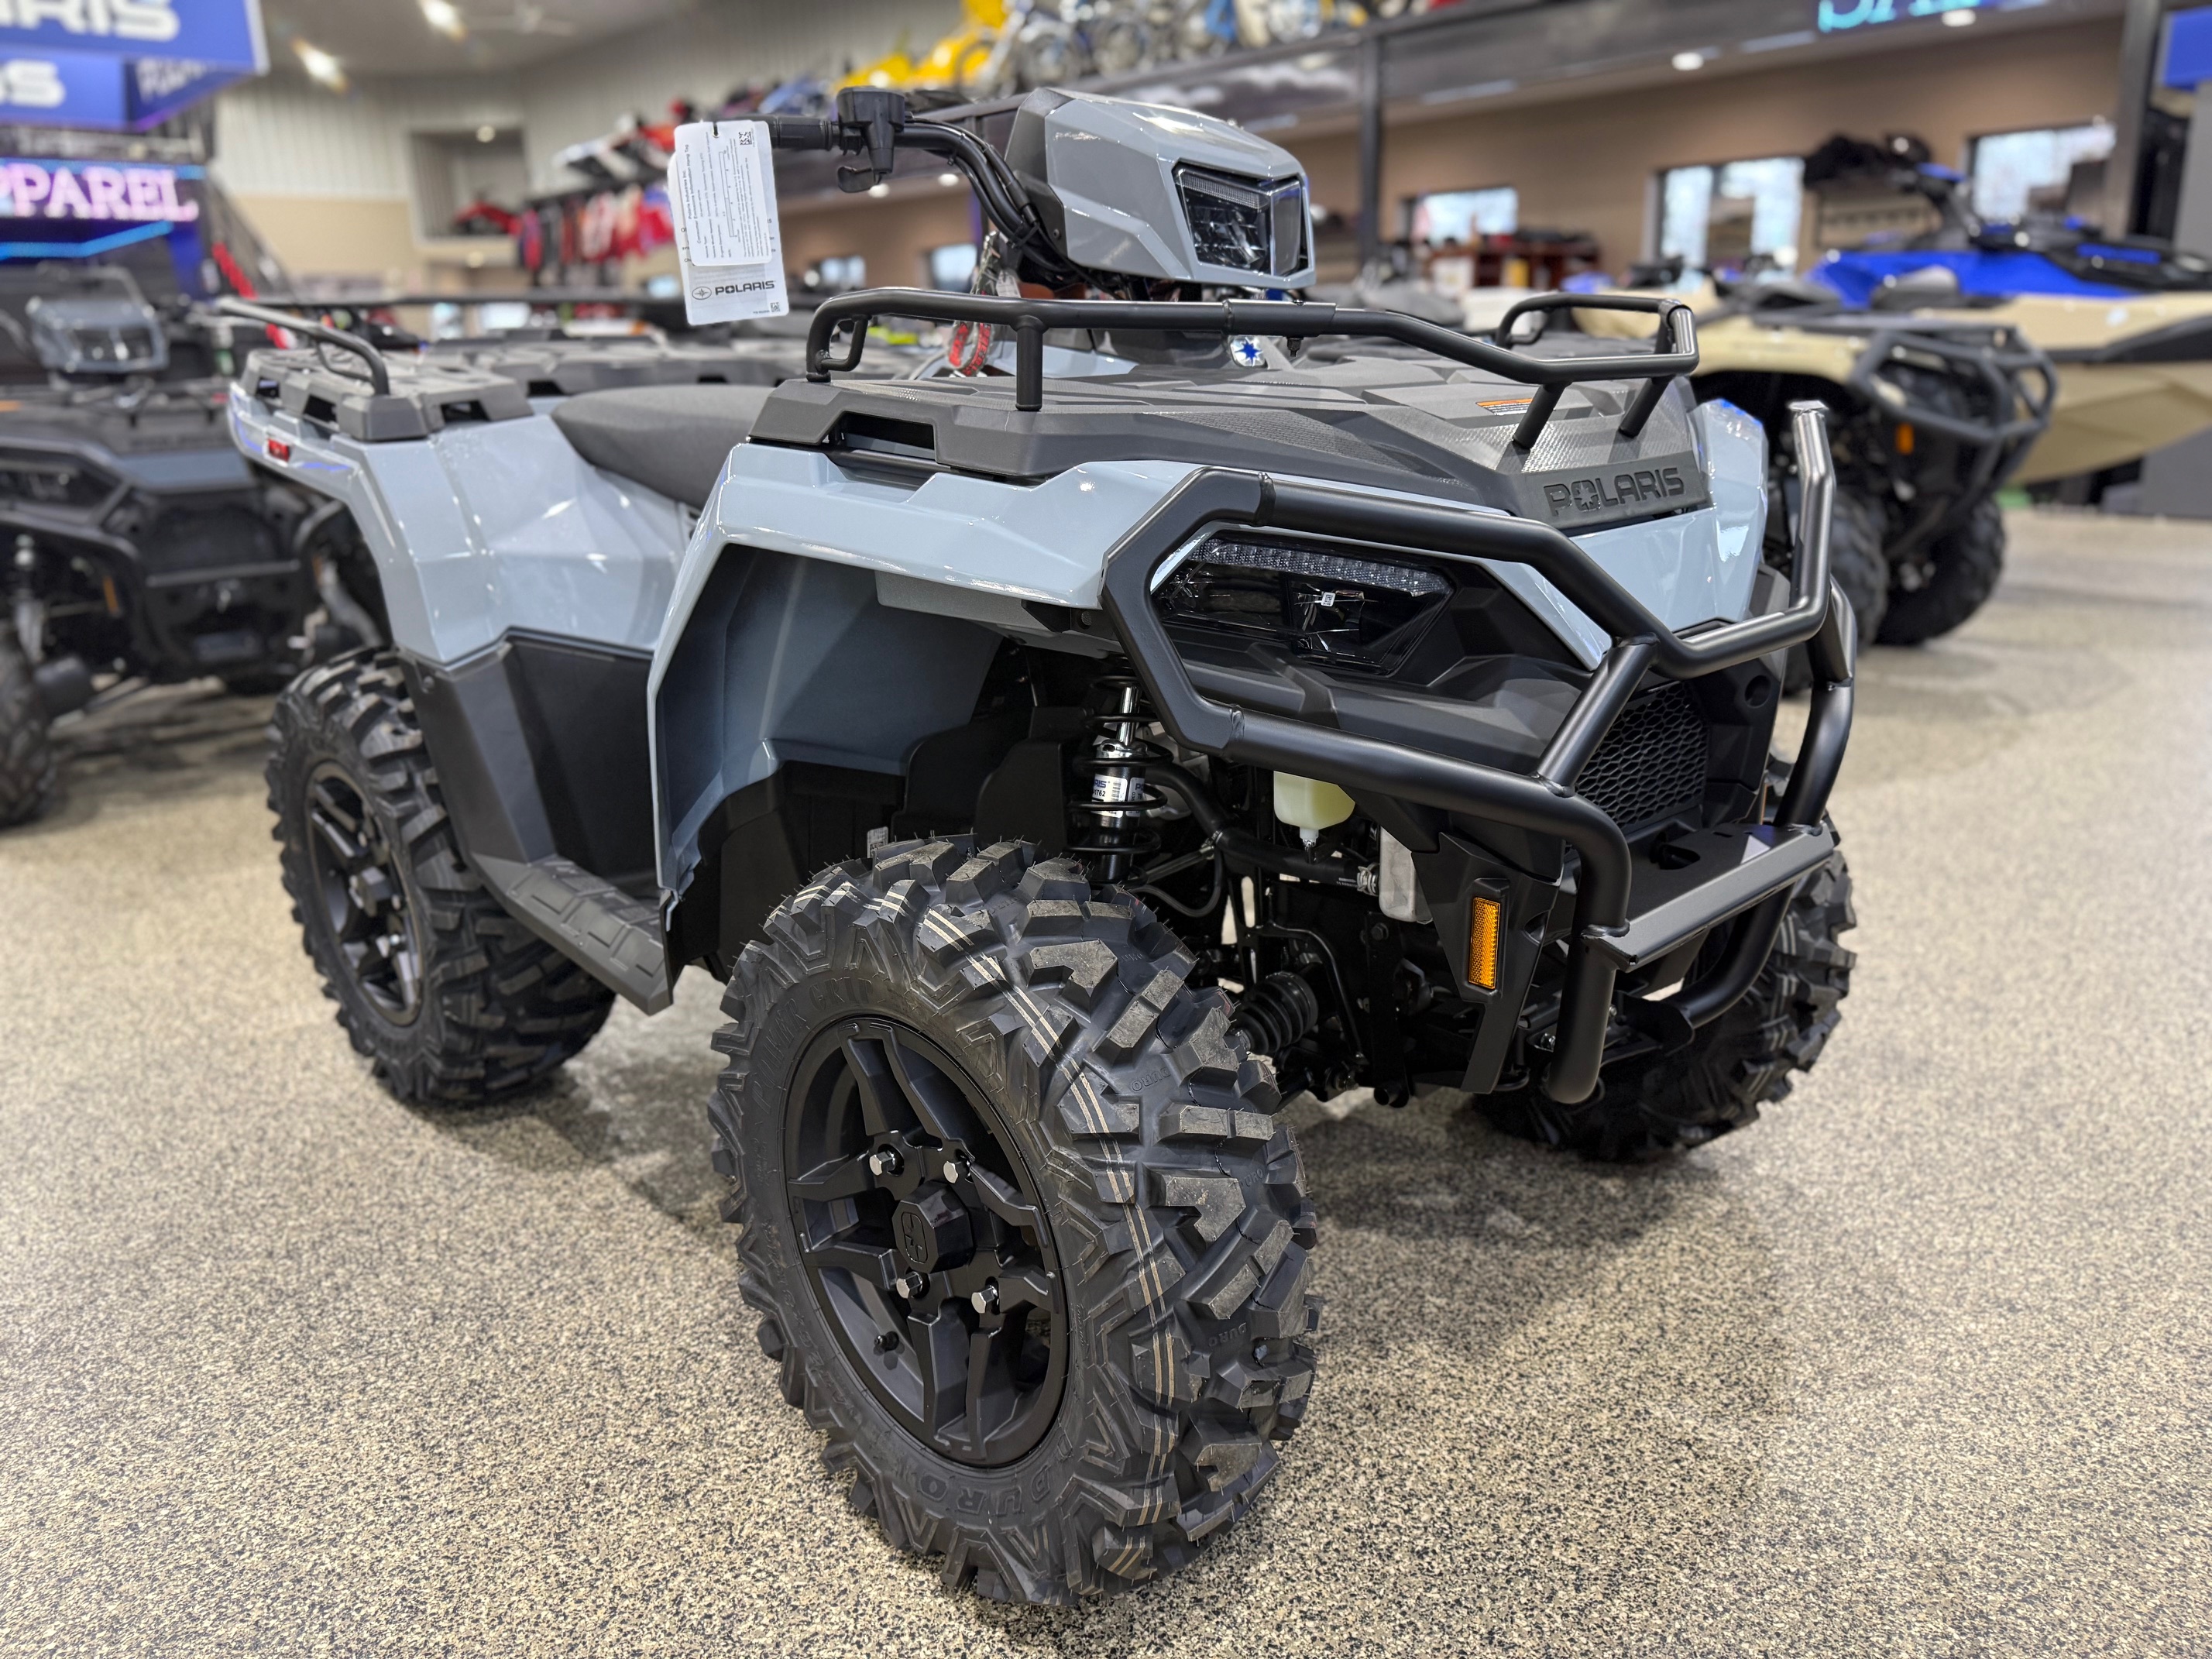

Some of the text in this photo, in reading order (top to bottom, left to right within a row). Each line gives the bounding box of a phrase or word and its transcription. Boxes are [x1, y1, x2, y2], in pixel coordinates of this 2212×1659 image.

[715, 280, 775, 295] POLARIS
[1544, 467, 1685, 517] POLARIS
[1131, 1066, 1172, 1092] DURO
[1208, 1321, 1247, 1347] DURO
[919, 1464, 1051, 1516] DURO
